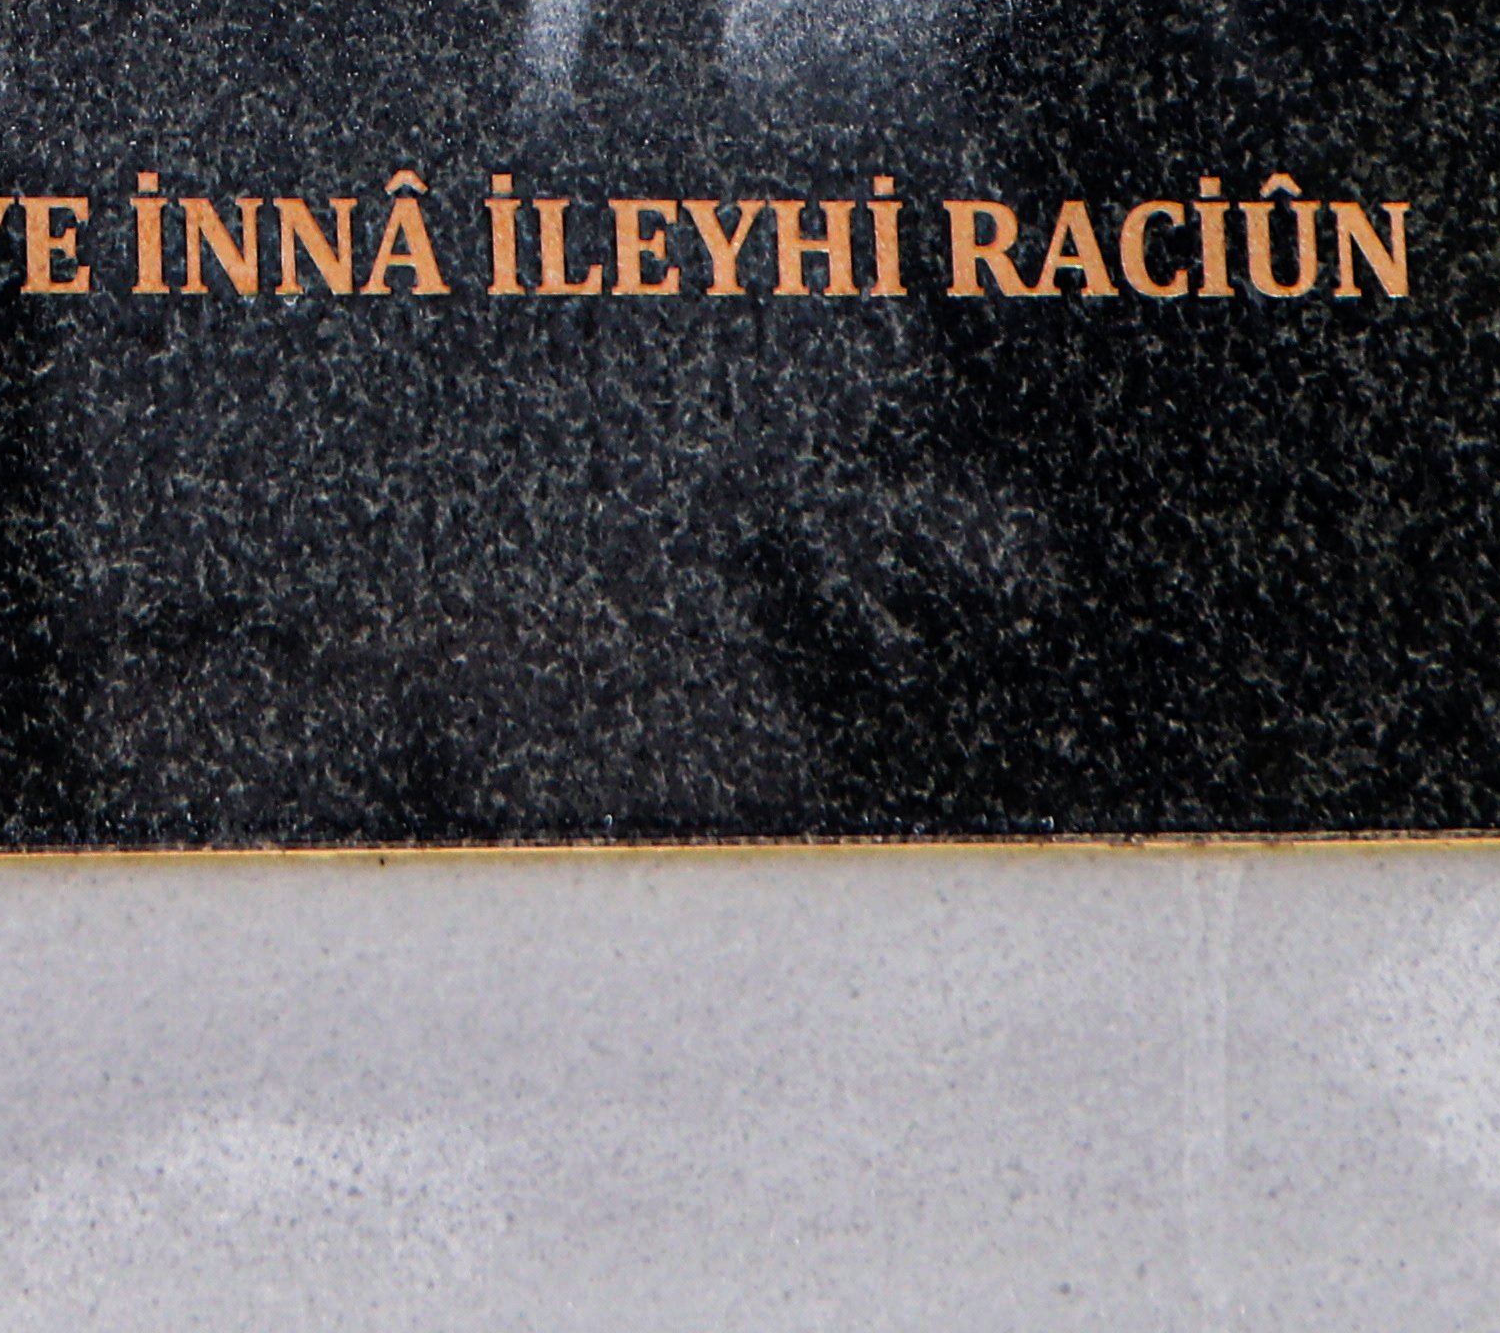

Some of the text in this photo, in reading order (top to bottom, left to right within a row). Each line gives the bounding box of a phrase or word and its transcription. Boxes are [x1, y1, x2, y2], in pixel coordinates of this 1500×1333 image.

[130, 169, 452, 296] İNNÂ
[484, 173, 909, 296] İLEYHİ
[942, 172, 1412, 298] RACİÛN
